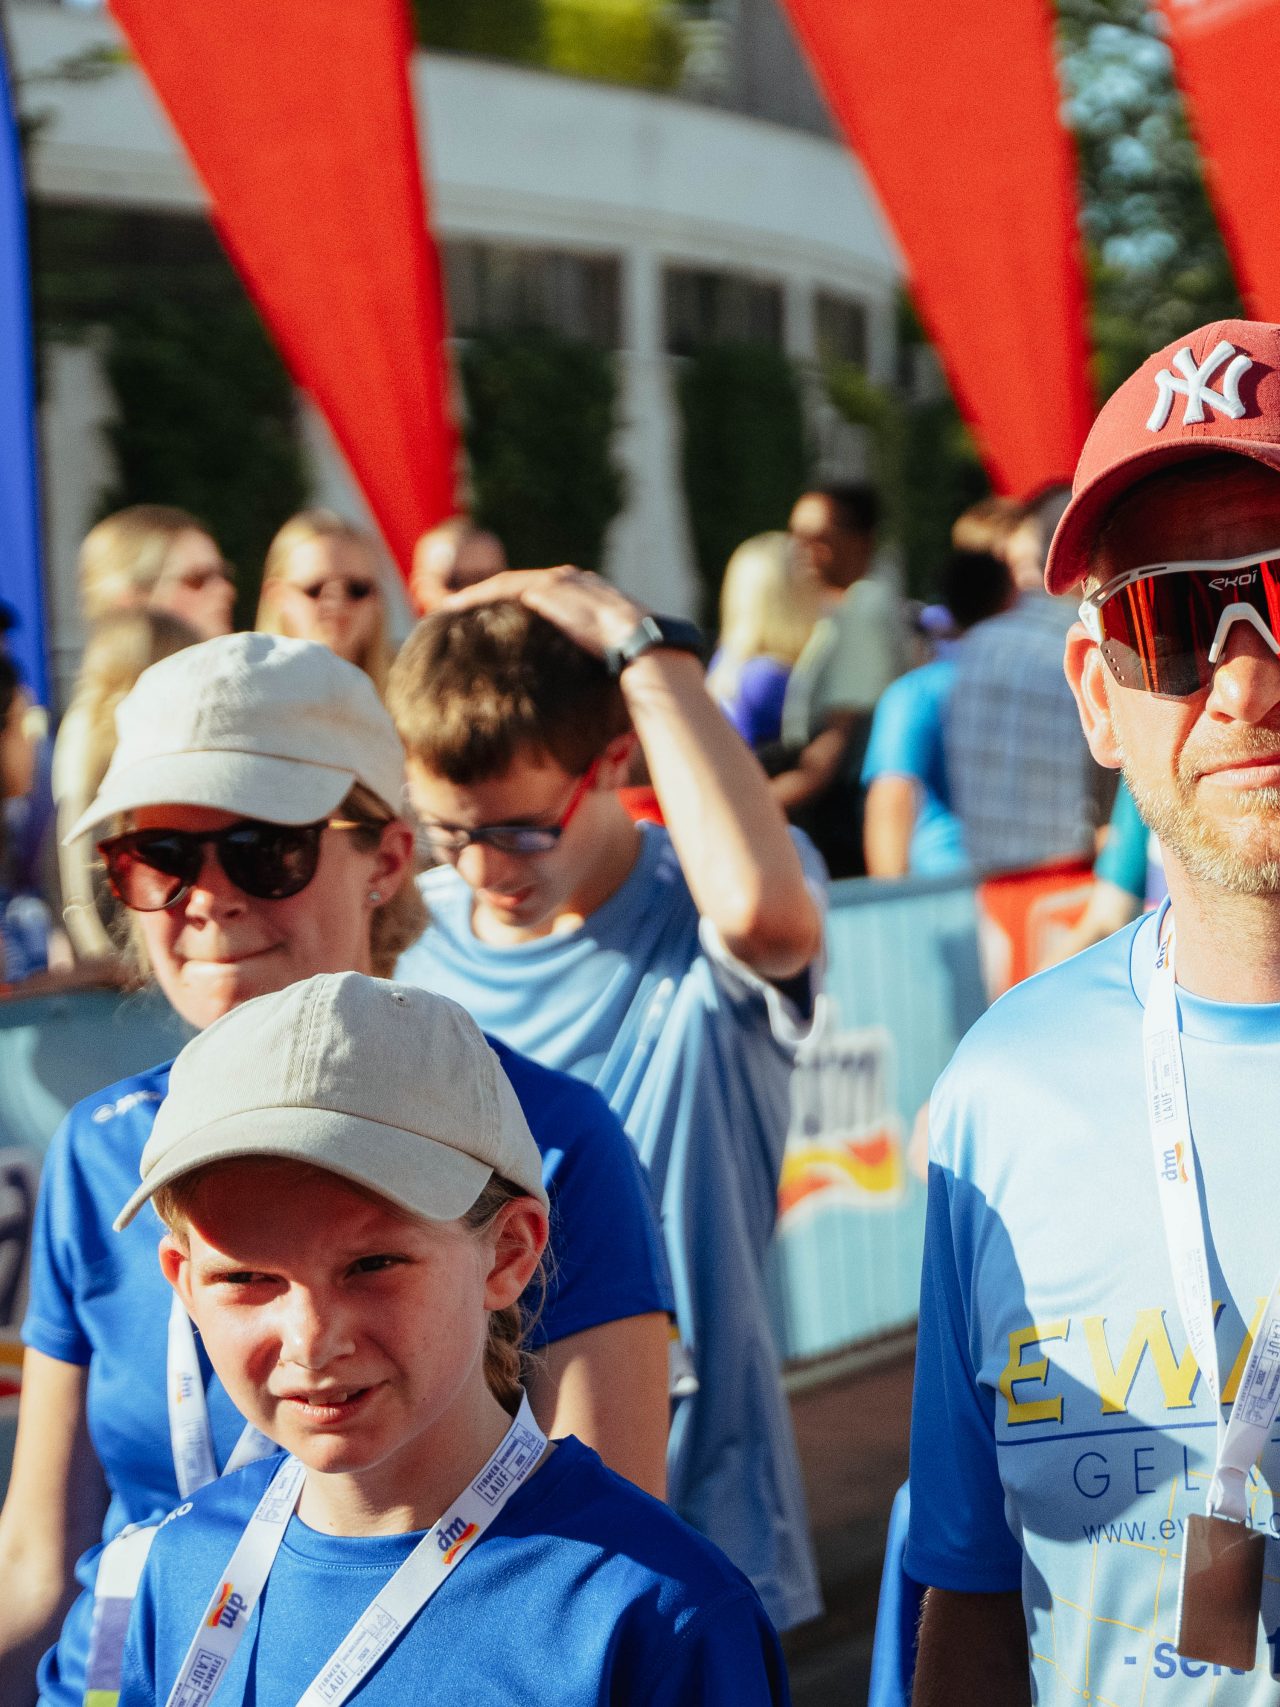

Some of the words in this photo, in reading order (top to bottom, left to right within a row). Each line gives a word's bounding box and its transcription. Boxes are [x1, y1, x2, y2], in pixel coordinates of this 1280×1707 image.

[1145, 339, 1253, 433] NY
[1160, 1148, 1176, 1182] dm
[477, 1463, 500, 1492] FIRMEN
[485, 1474, 509, 1501] LAUF
[436, 1517, 467, 1552] dm
[220, 1592, 248, 1629] dm
[190, 1655, 207, 1687] LAUF
[203, 1659, 222, 1693] FIRMEN
[318, 1663, 341, 1691] FIRMEN
[324, 1671, 348, 1699] LAUF
